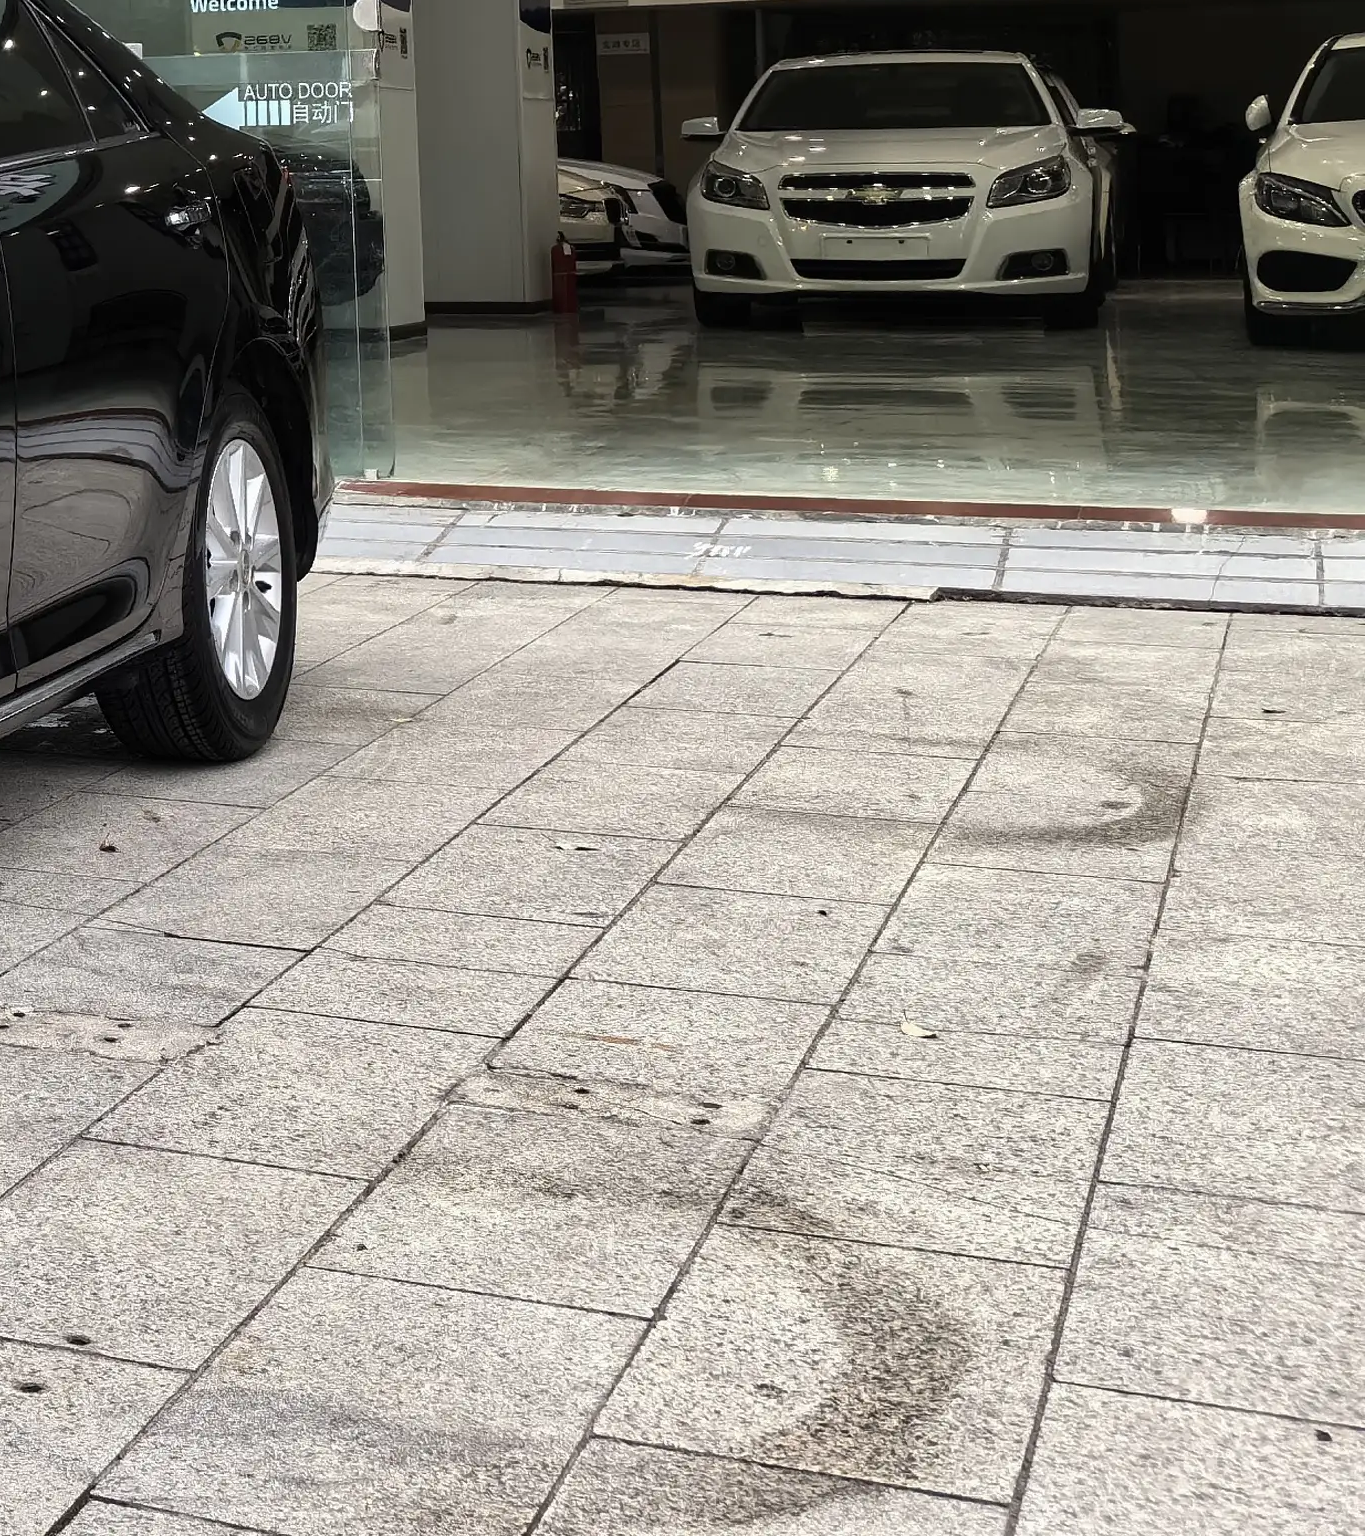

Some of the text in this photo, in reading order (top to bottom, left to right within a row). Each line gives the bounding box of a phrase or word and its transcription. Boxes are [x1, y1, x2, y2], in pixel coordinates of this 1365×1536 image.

[244, 82, 353, 100] AUTO DOOR
[293, 101, 354, 124] 自动门
